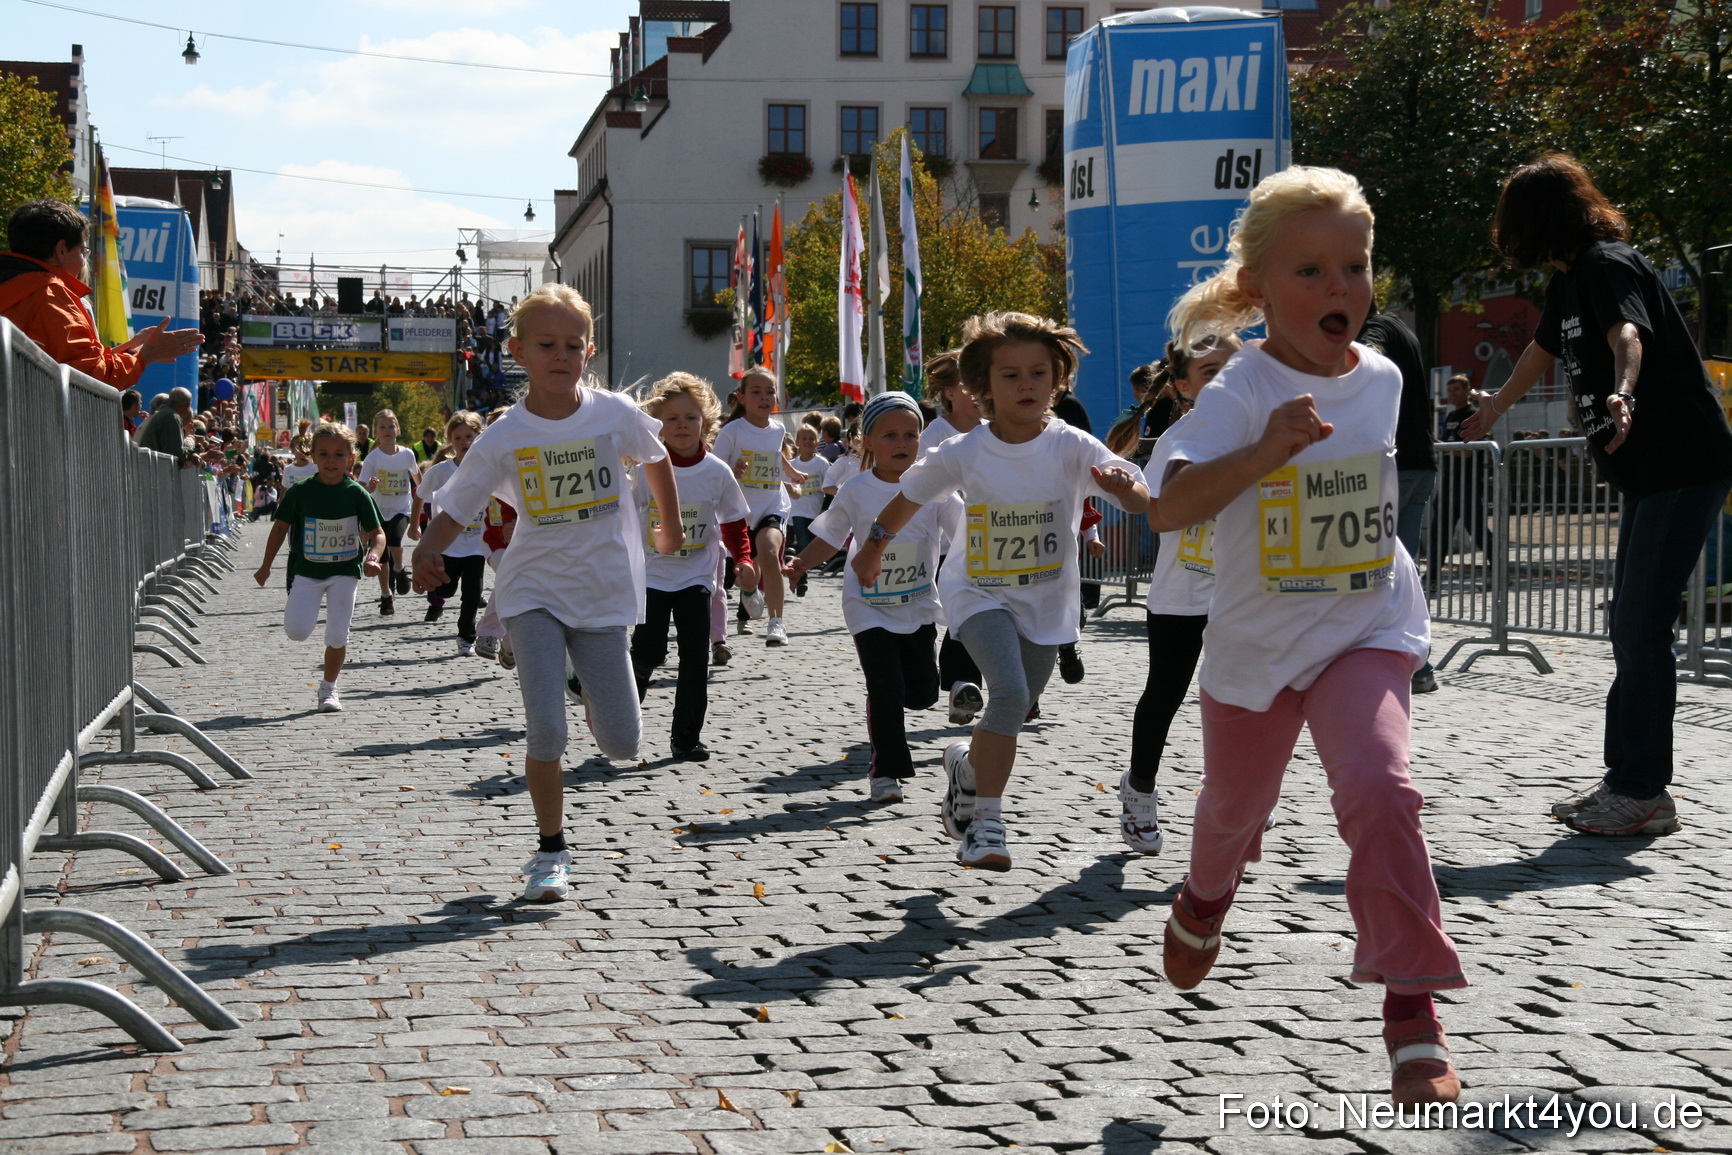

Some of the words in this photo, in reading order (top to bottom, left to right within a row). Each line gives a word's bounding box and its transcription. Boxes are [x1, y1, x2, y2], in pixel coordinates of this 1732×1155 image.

[1128, 42, 1262, 115] maxi
[1214, 149, 1262, 189] dsl
[1070, 157, 1094, 200] dsl
[118, 222, 171, 263] axi
[132, 284, 166, 311] dsl
[273, 322, 355, 340] BOCK
[405, 328, 452, 337] PFLEIDERER
[310, 356, 382, 373] START
[544, 446, 596, 466] Victoria
[754, 453, 768, 462] Elisa
[754, 466, 780, 477] 7219
[388, 480, 407, 488] 7212
[550, 466, 612, 498] 7210
[1306, 470, 1368, 499] Melina
[681, 508, 698, 518] anie
[991, 510, 1054, 527] Katharina
[318, 522, 342, 532] Svenja
[683, 524, 706, 539] 17
[1311, 501, 1394, 551] 7056
[320, 534, 355, 548] 7035
[994, 532, 1058, 560] 7216
[882, 562, 926, 586] 7224
[1280, 580, 1325, 588] BOCK
